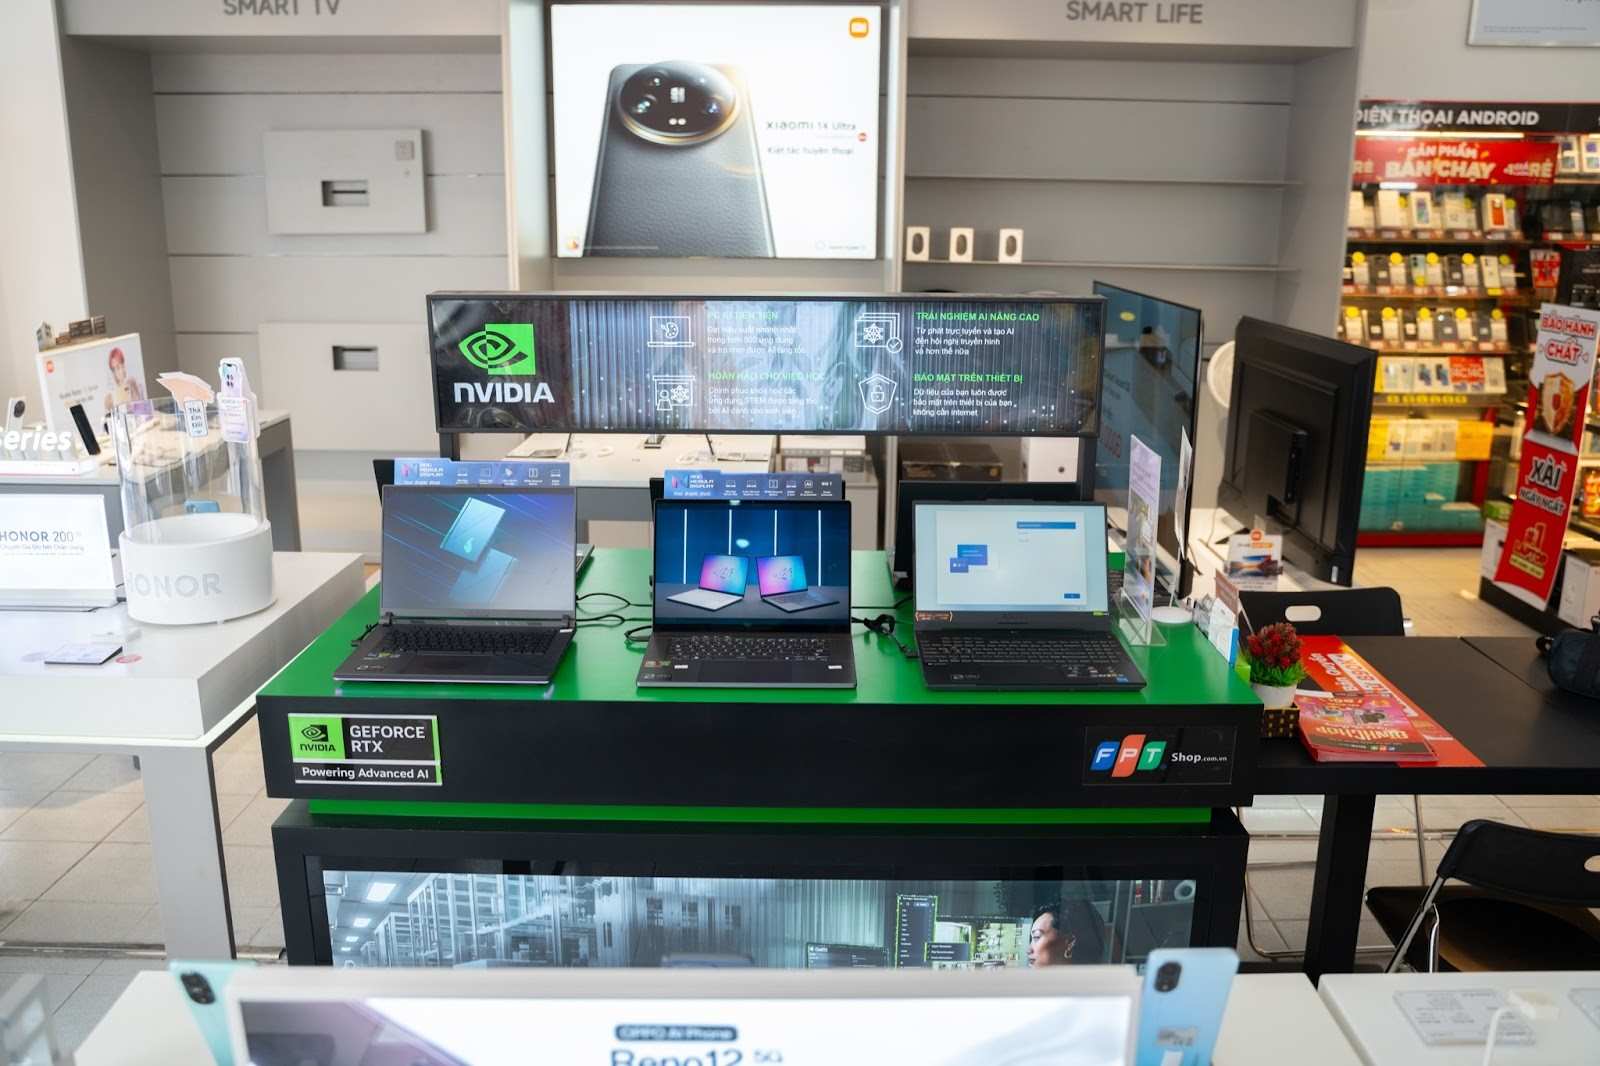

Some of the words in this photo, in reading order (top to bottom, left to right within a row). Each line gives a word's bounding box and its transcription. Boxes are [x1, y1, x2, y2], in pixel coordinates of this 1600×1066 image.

[1066, 1, 1149, 23] SMART
[1156, 3, 1203, 24] LIFE
[1398, 108, 1454, 127] THOẠI
[1456, 110, 1540, 126] ANDROID
[1385, 159, 1432, 178] BÁN
[1435, 160, 1497, 182] CHẠY
[940, 311, 977, 322] NGHIỆM
[979, 312, 988, 321] AI
[1019, 313, 1040, 321] CAO
[958, 373, 983, 382] TRÊN
[985, 373, 1012, 382] THIẾT
[1013, 374, 1024, 384] BỊ
[454, 382, 555, 403] NVIDIA
[956, 389, 969, 397] bạn
[999, 399, 1013, 408] bạn
[913, 408, 935, 417] không
[951, 408, 978, 416] internet
[0, 430, 73, 451] eries
[1529, 456, 1564, 488] XÀI
[0, 531, 48, 542] HONOR
[53, 531, 73, 542] 200
[349, 726, 425, 738] GEFORCE
[351, 740, 384, 752] RTX
[302, 767, 355, 779] Powering
[358, 768, 414, 778] Advanced
[417, 769, 429, 779] AI
